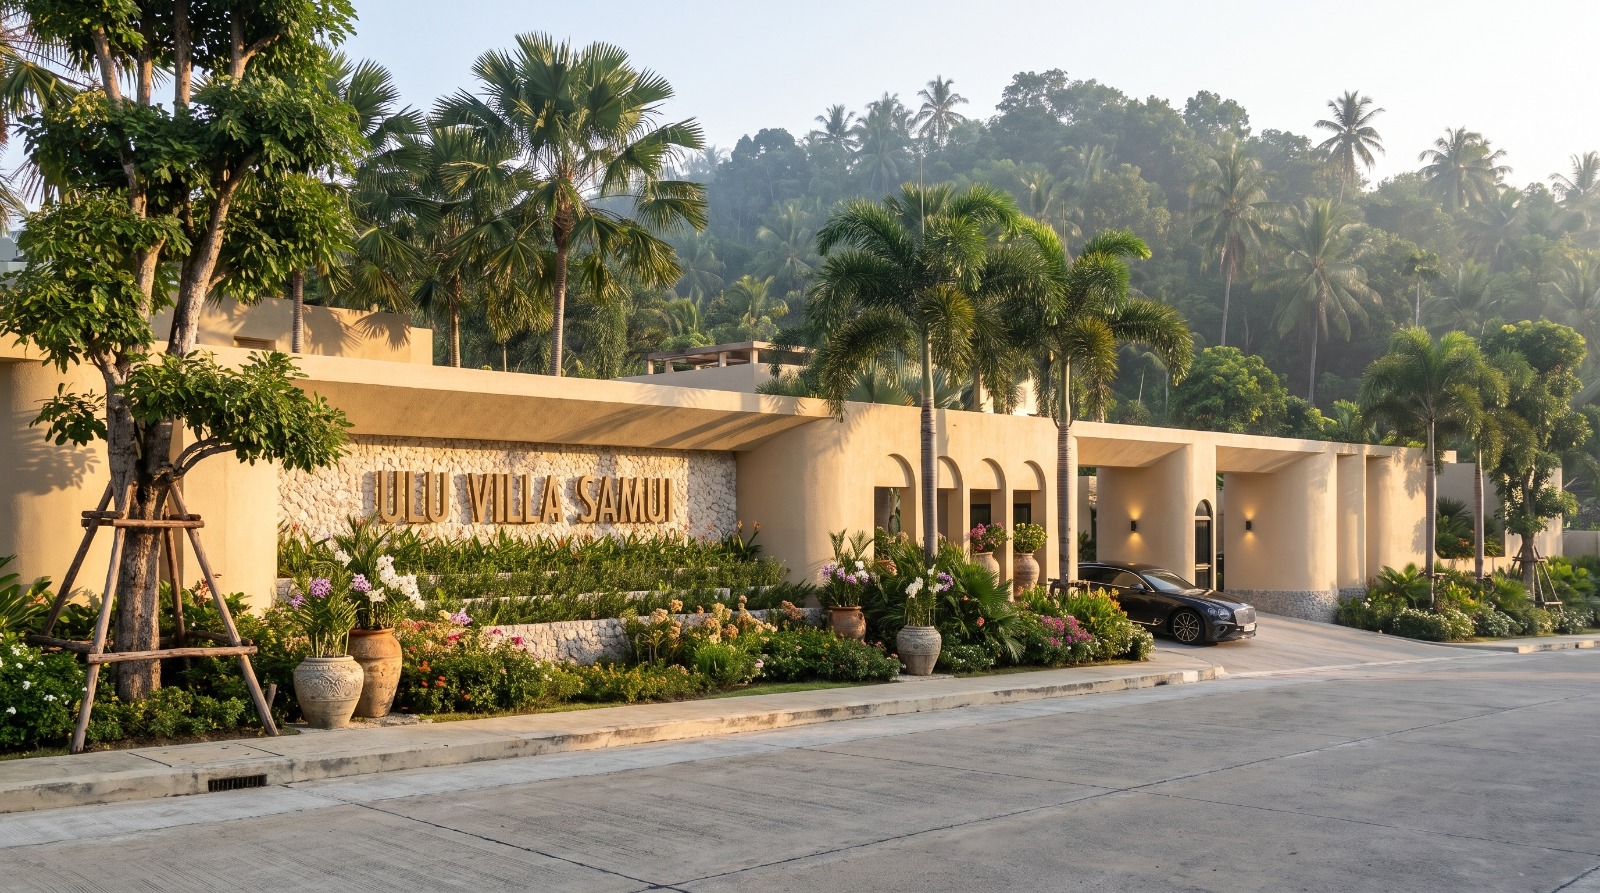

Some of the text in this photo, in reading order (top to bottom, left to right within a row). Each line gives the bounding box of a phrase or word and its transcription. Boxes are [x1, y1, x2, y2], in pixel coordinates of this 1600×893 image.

[377, 470, 673, 523] ULU VILLA SAMUI
